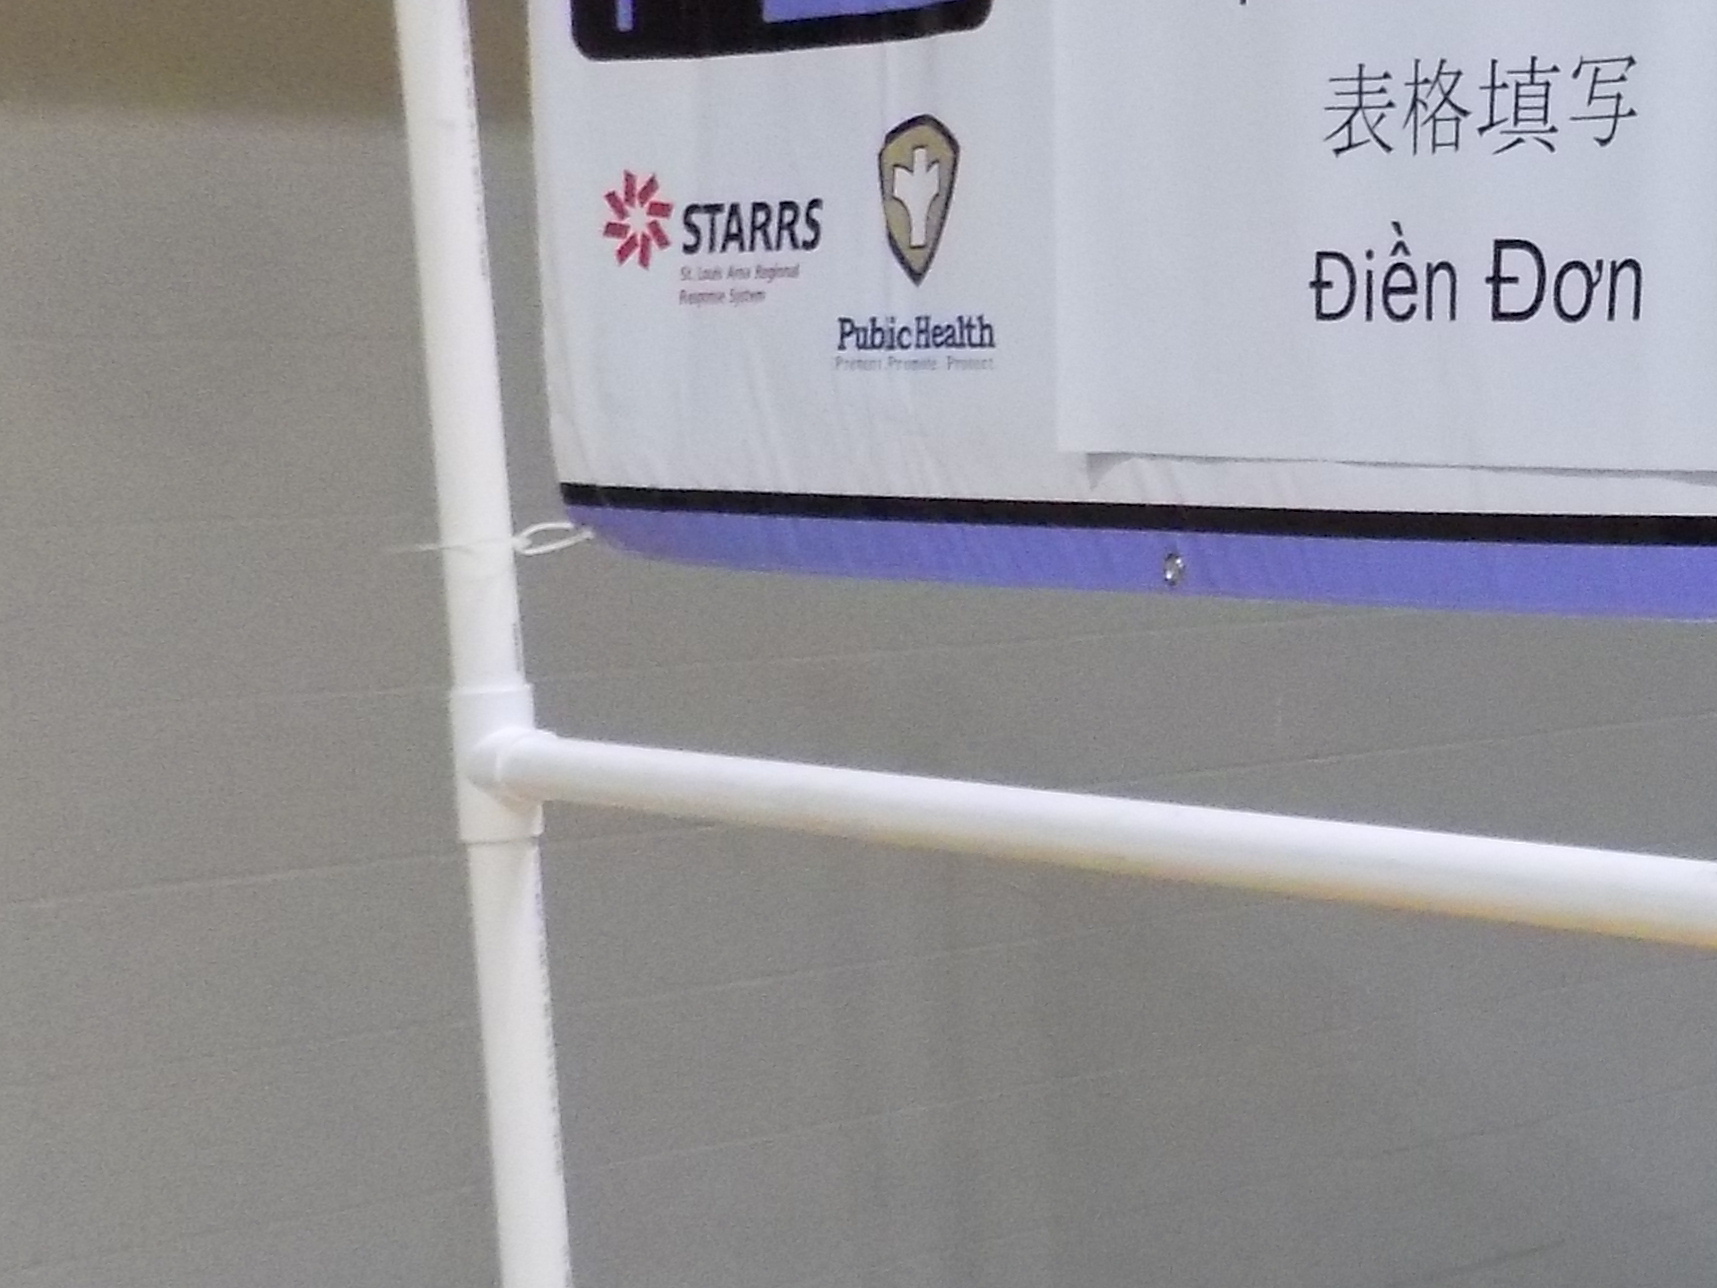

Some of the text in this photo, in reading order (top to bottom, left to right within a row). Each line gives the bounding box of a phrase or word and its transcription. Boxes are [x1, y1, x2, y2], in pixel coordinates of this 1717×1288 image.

[1322, 55, 1638, 158] 表格填写
[681, 198, 824, 255] STARRS
[1308, 220, 1643, 324] Điền Đơn
